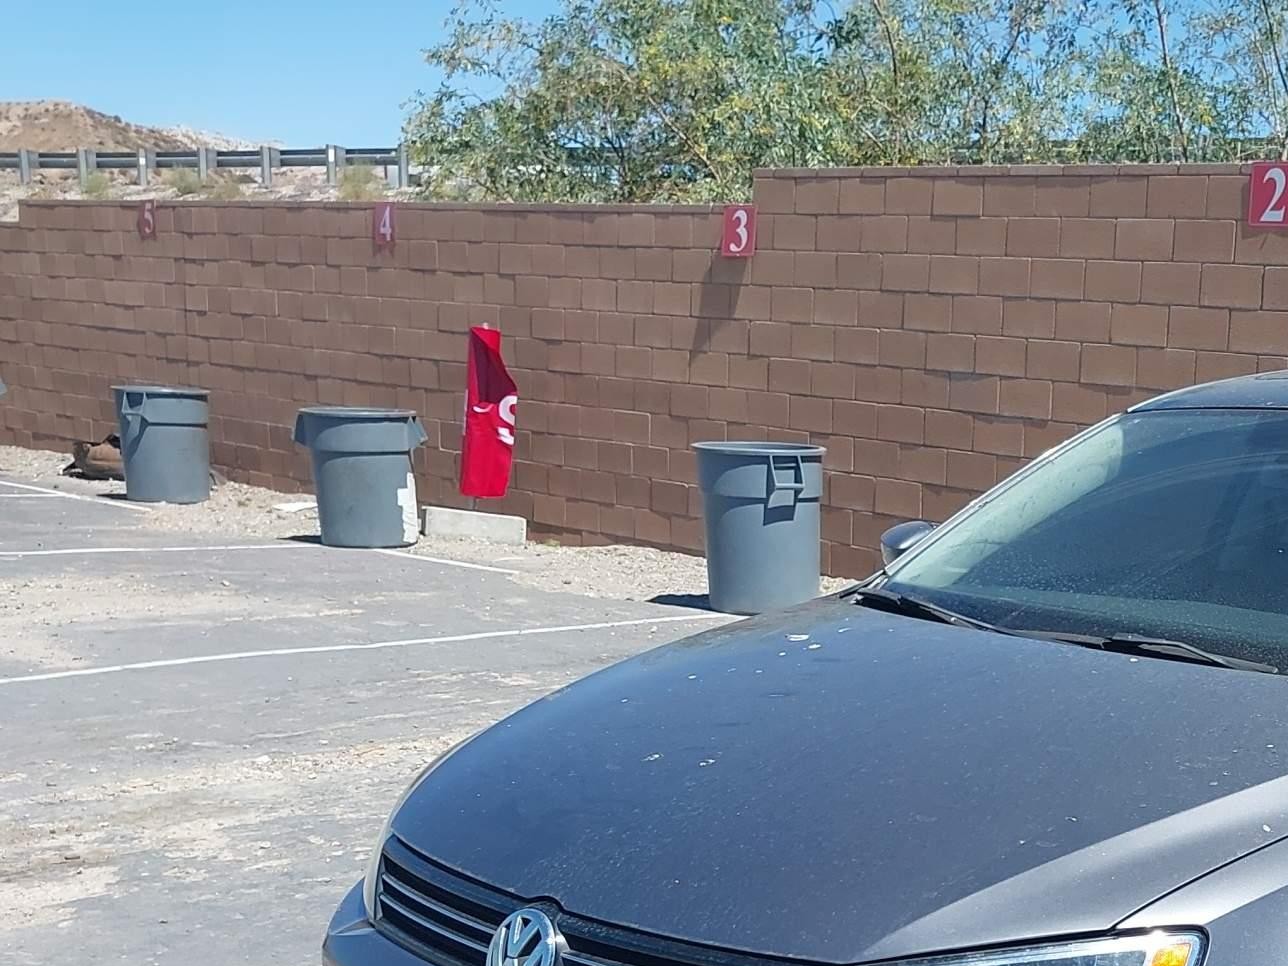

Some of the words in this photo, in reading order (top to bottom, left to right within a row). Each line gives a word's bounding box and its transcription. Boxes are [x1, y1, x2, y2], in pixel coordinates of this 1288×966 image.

[1259, 167, 1286, 222] 2
[143, 202, 153, 234] 5
[380, 205, 392, 241] 4
[729, 209, 748, 252] 3
